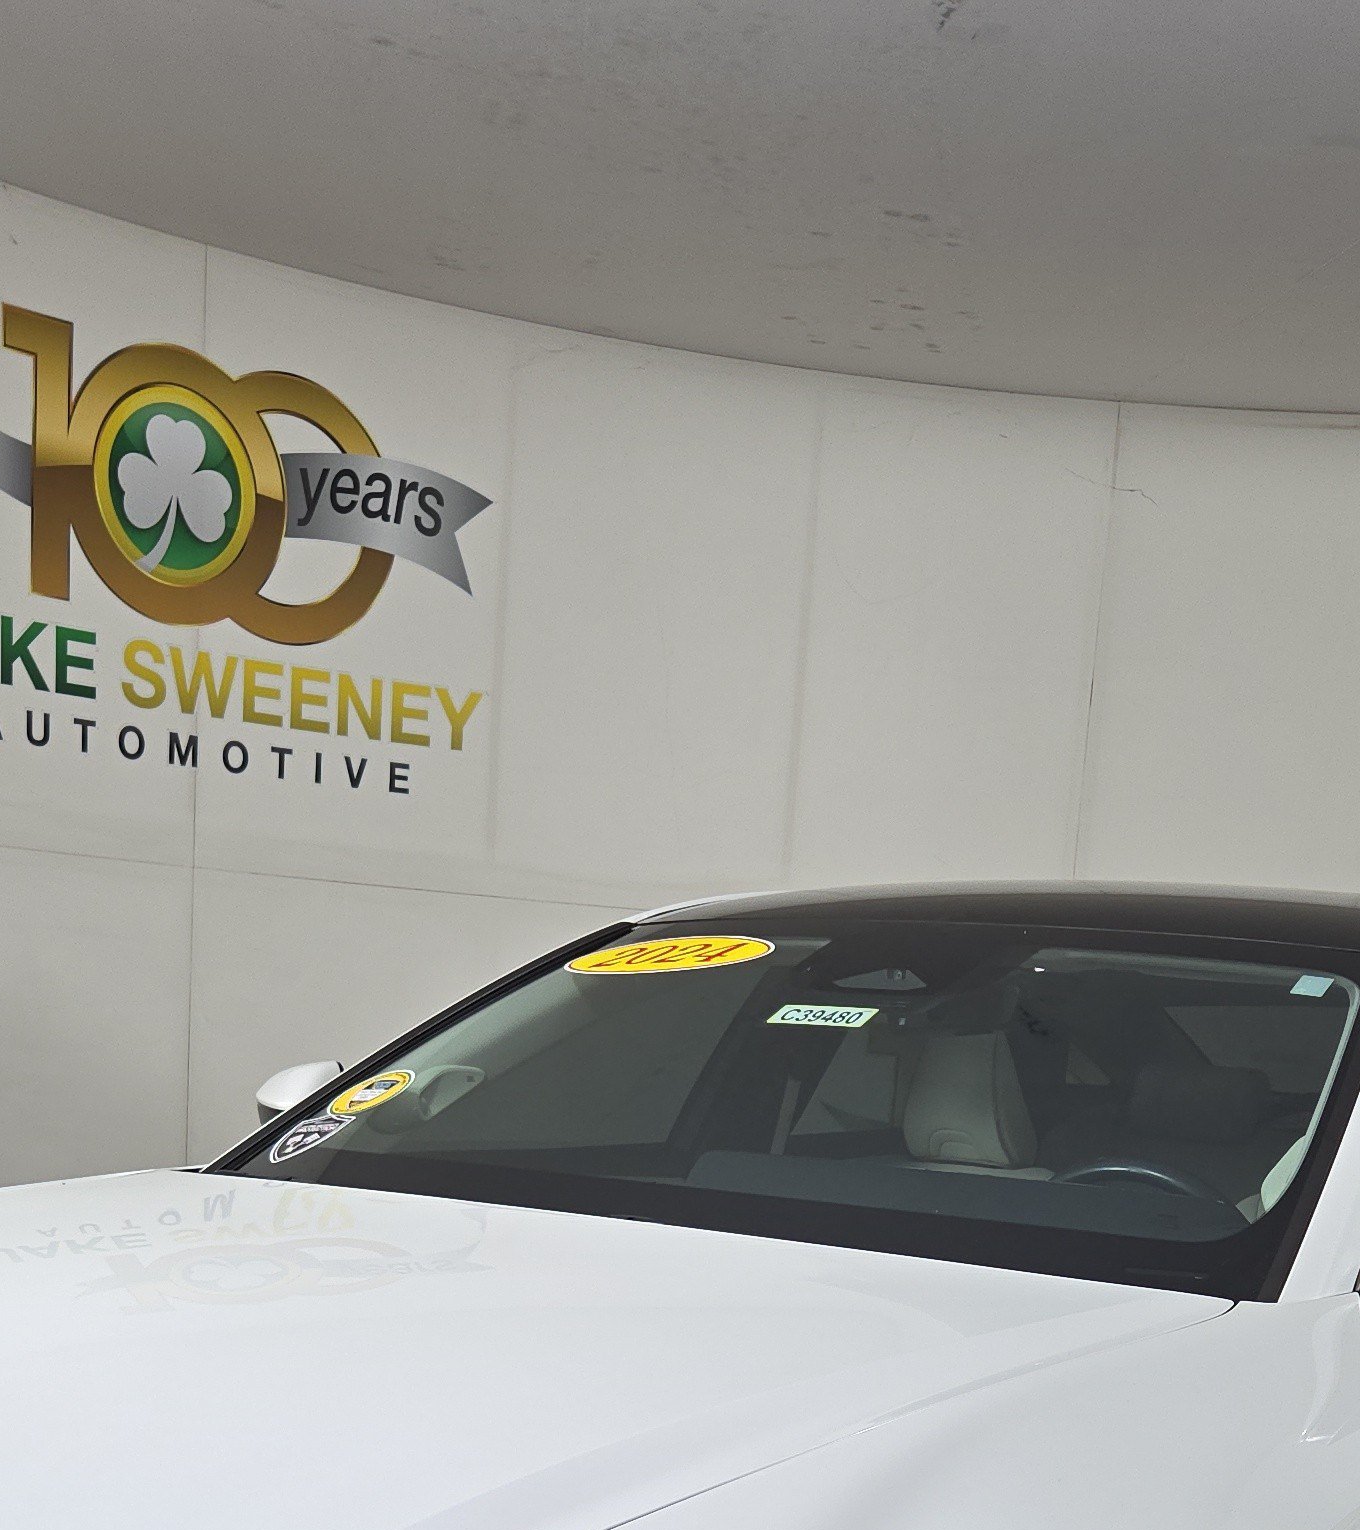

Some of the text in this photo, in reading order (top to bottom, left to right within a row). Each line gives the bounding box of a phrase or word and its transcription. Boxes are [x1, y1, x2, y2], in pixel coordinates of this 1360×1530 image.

[296, 466, 446, 537] years
[121, 638, 483, 751] SWEENEY
[588, 942, 748, 968] 2024
[780, 1008, 864, 1024] C39480
